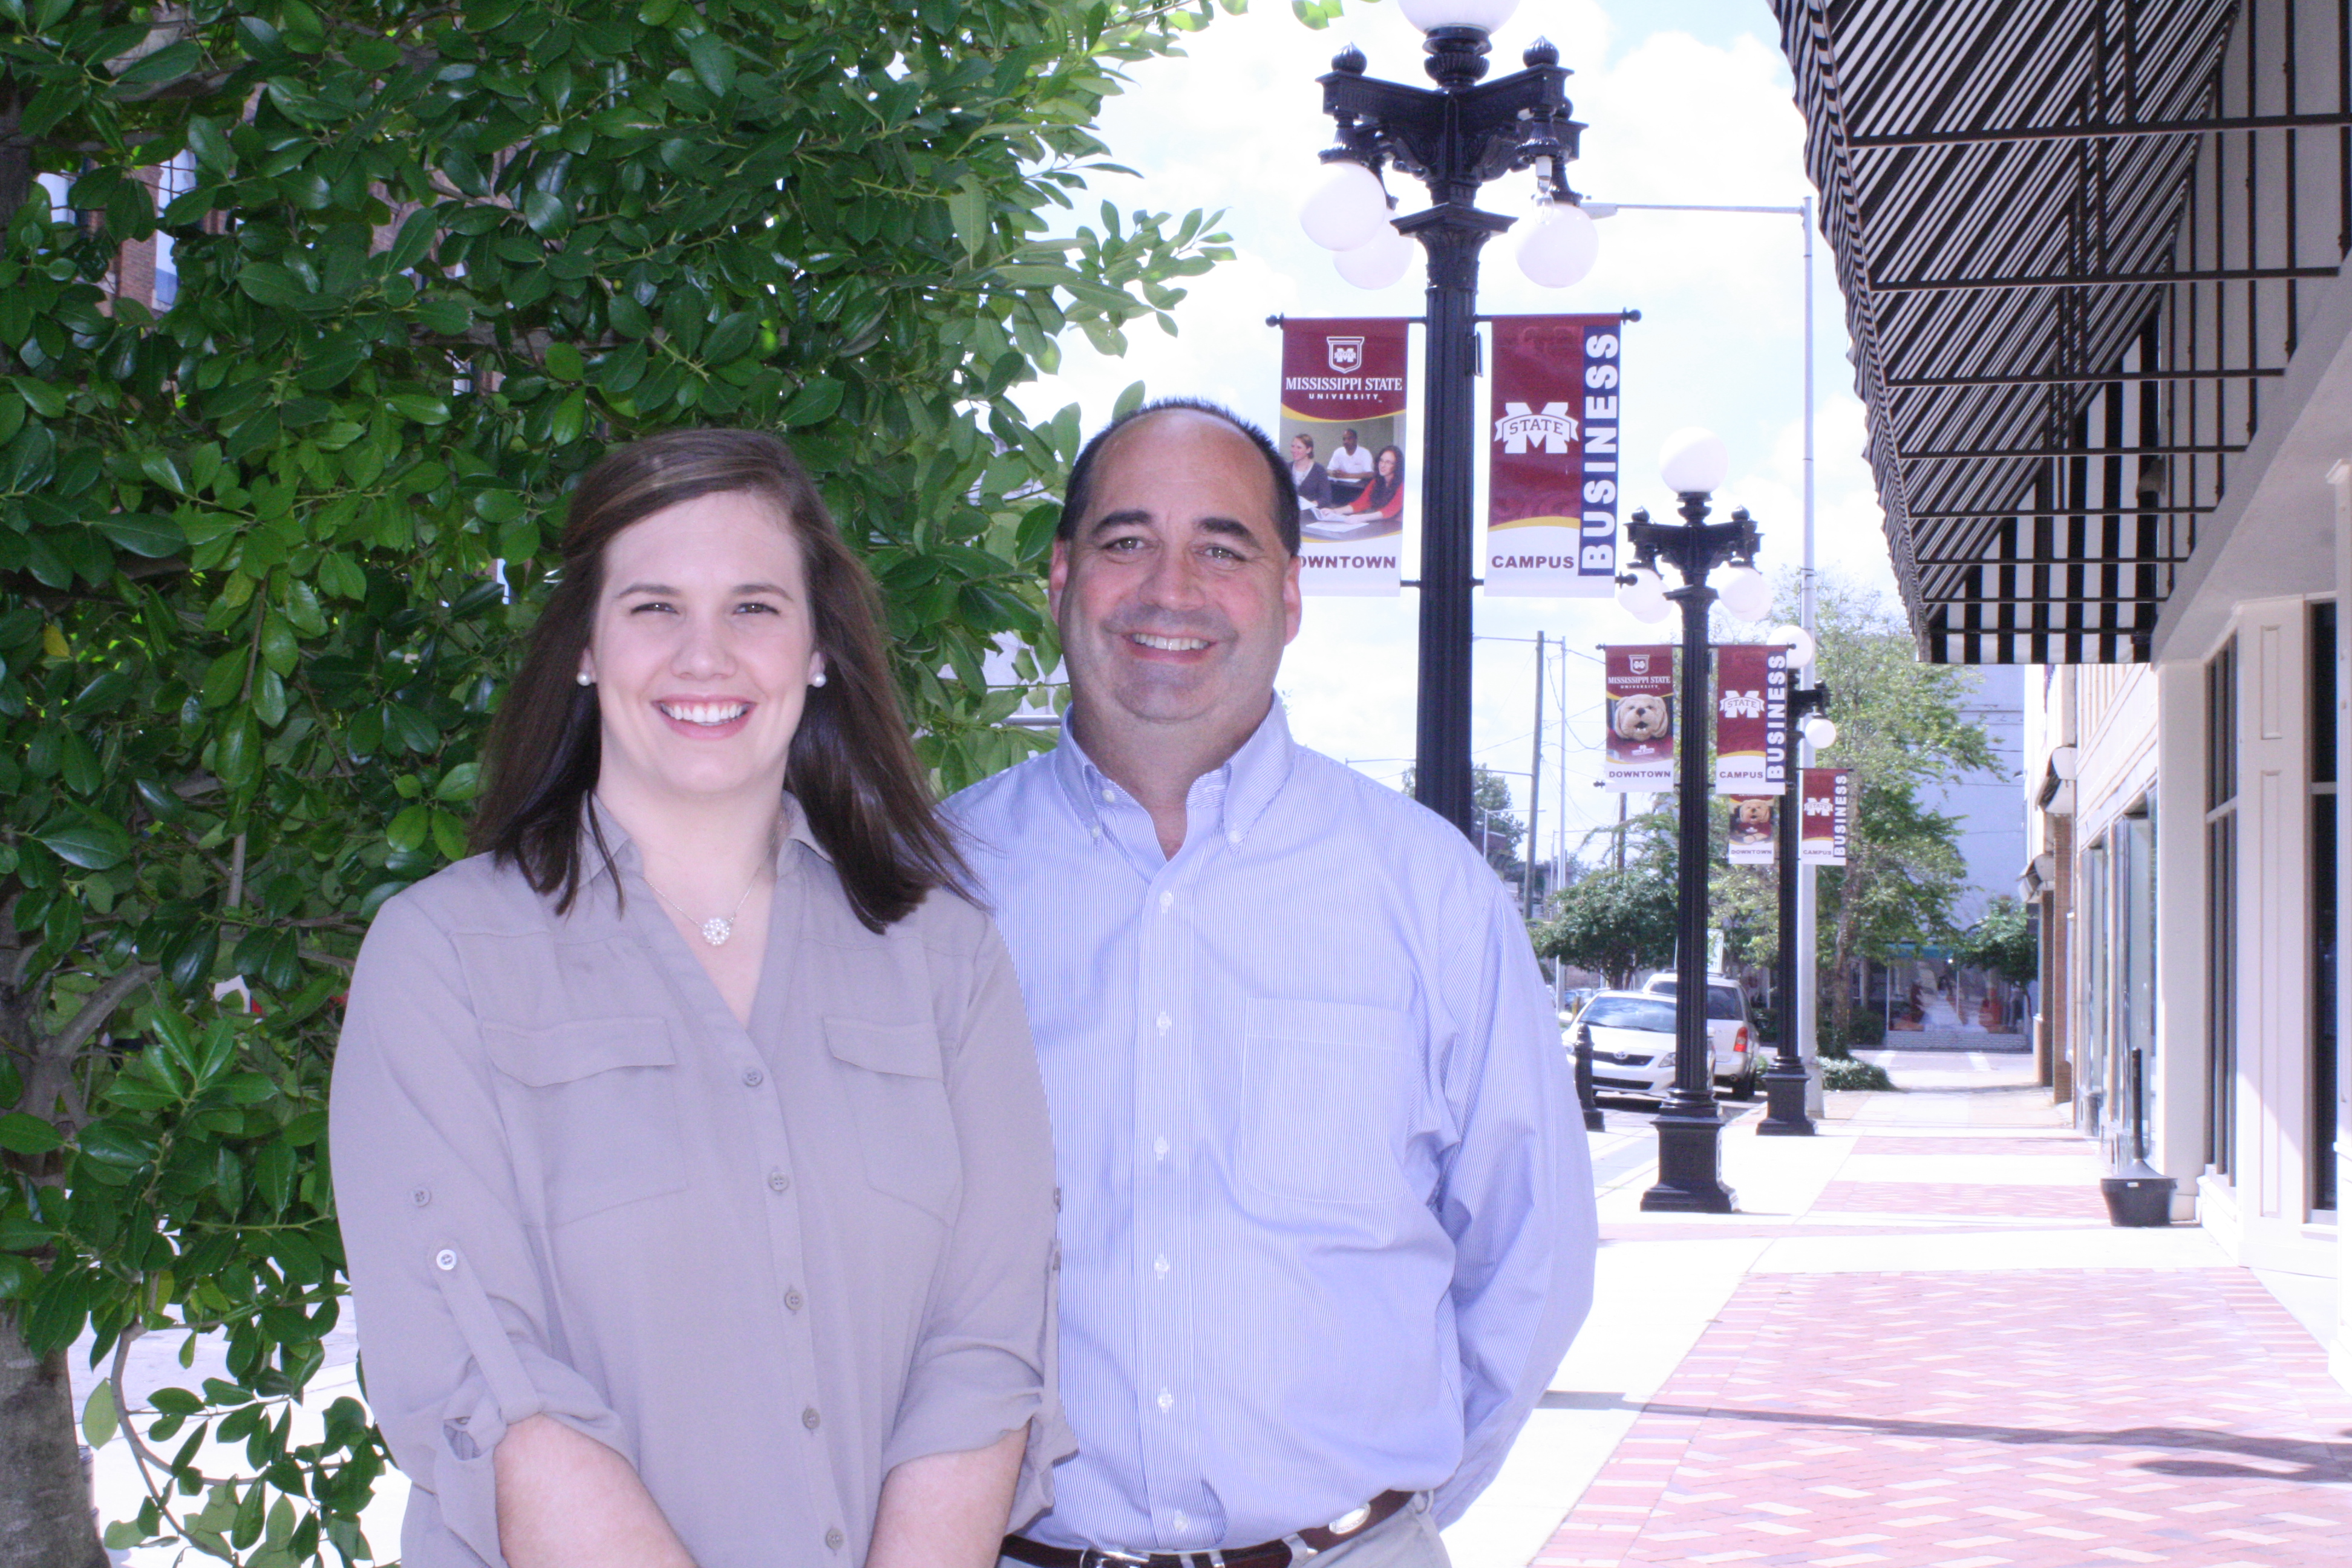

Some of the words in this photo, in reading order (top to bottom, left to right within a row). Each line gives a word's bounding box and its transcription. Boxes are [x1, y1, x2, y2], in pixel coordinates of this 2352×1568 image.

[1285, 377, 1361, 390] MISSISSIPPI
[1365, 377, 1402, 391] STATE
[1509, 418, 1564, 435] STATE
[1581, 334, 1618, 569] BUSINESS
[1301, 555, 1396, 569] WNTOWN
[1492, 555, 1574, 569] CAMPUS
[1727, 699, 1757, 708] STATE
[1766, 655, 1785, 779] BUSINESS
[1834, 775, 1847, 856] BUSINESS
